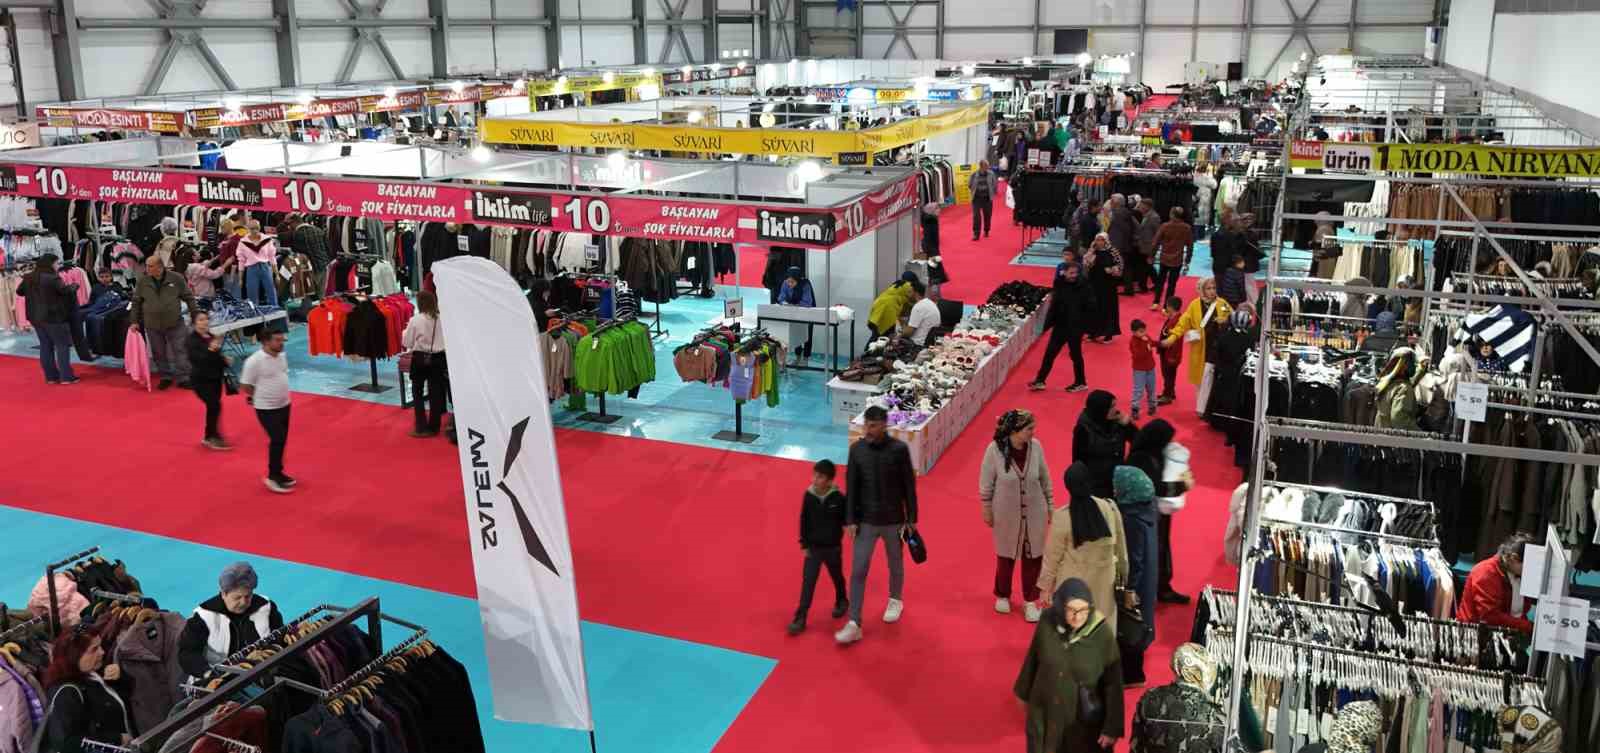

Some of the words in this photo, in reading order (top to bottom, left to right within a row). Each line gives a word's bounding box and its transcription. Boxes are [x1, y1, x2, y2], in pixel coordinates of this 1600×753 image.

[1325, 150, 1370, 170] ürün
[1377, 145, 1390, 171] 1
[1400, 148, 1480, 172] MODA
[36, 167, 68, 195] 10
[112, 169, 163, 184] BAŞLAYAN
[99, 186, 118, 200] ŞOK
[121, 184, 178, 200] FİYATLARLA
[246, 191, 260, 206] life
[284, 179, 323, 212] 10
[377, 183, 437, 200] BAŞLAYAN
[360, 200, 384, 216] ŞOK
[387, 200, 456, 218] FİYATLARLA
[532, 208, 548, 226] life
[565, 198, 611, 232] 10
[661, 205, 720, 220] BAŞLAYAN
[643, 223, 666, 236] ŞOK
[669, 221, 735, 239] FİYATLARLA
[1560, 617, 1580, 629] 50
